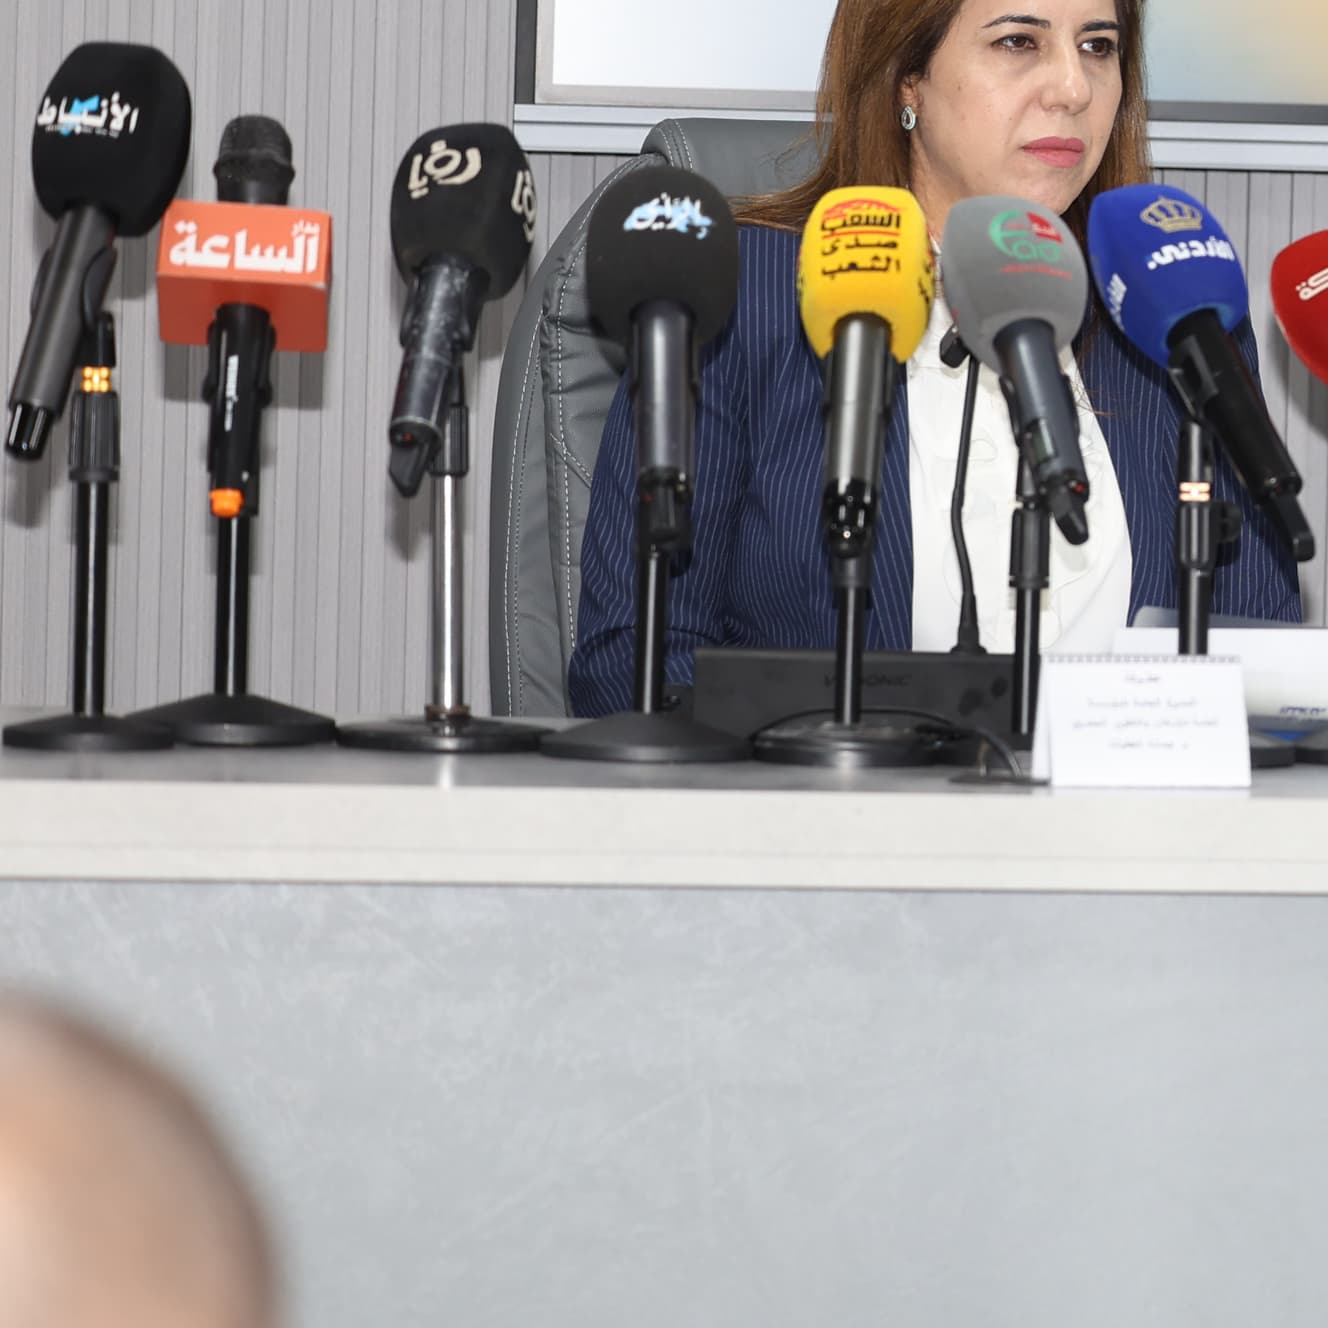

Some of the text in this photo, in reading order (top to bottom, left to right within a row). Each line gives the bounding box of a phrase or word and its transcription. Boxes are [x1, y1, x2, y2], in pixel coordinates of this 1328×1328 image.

[169, 221, 320, 274] الساعة
[821, 236, 899, 256] صدى
[821, 255, 902, 280] الشعب
